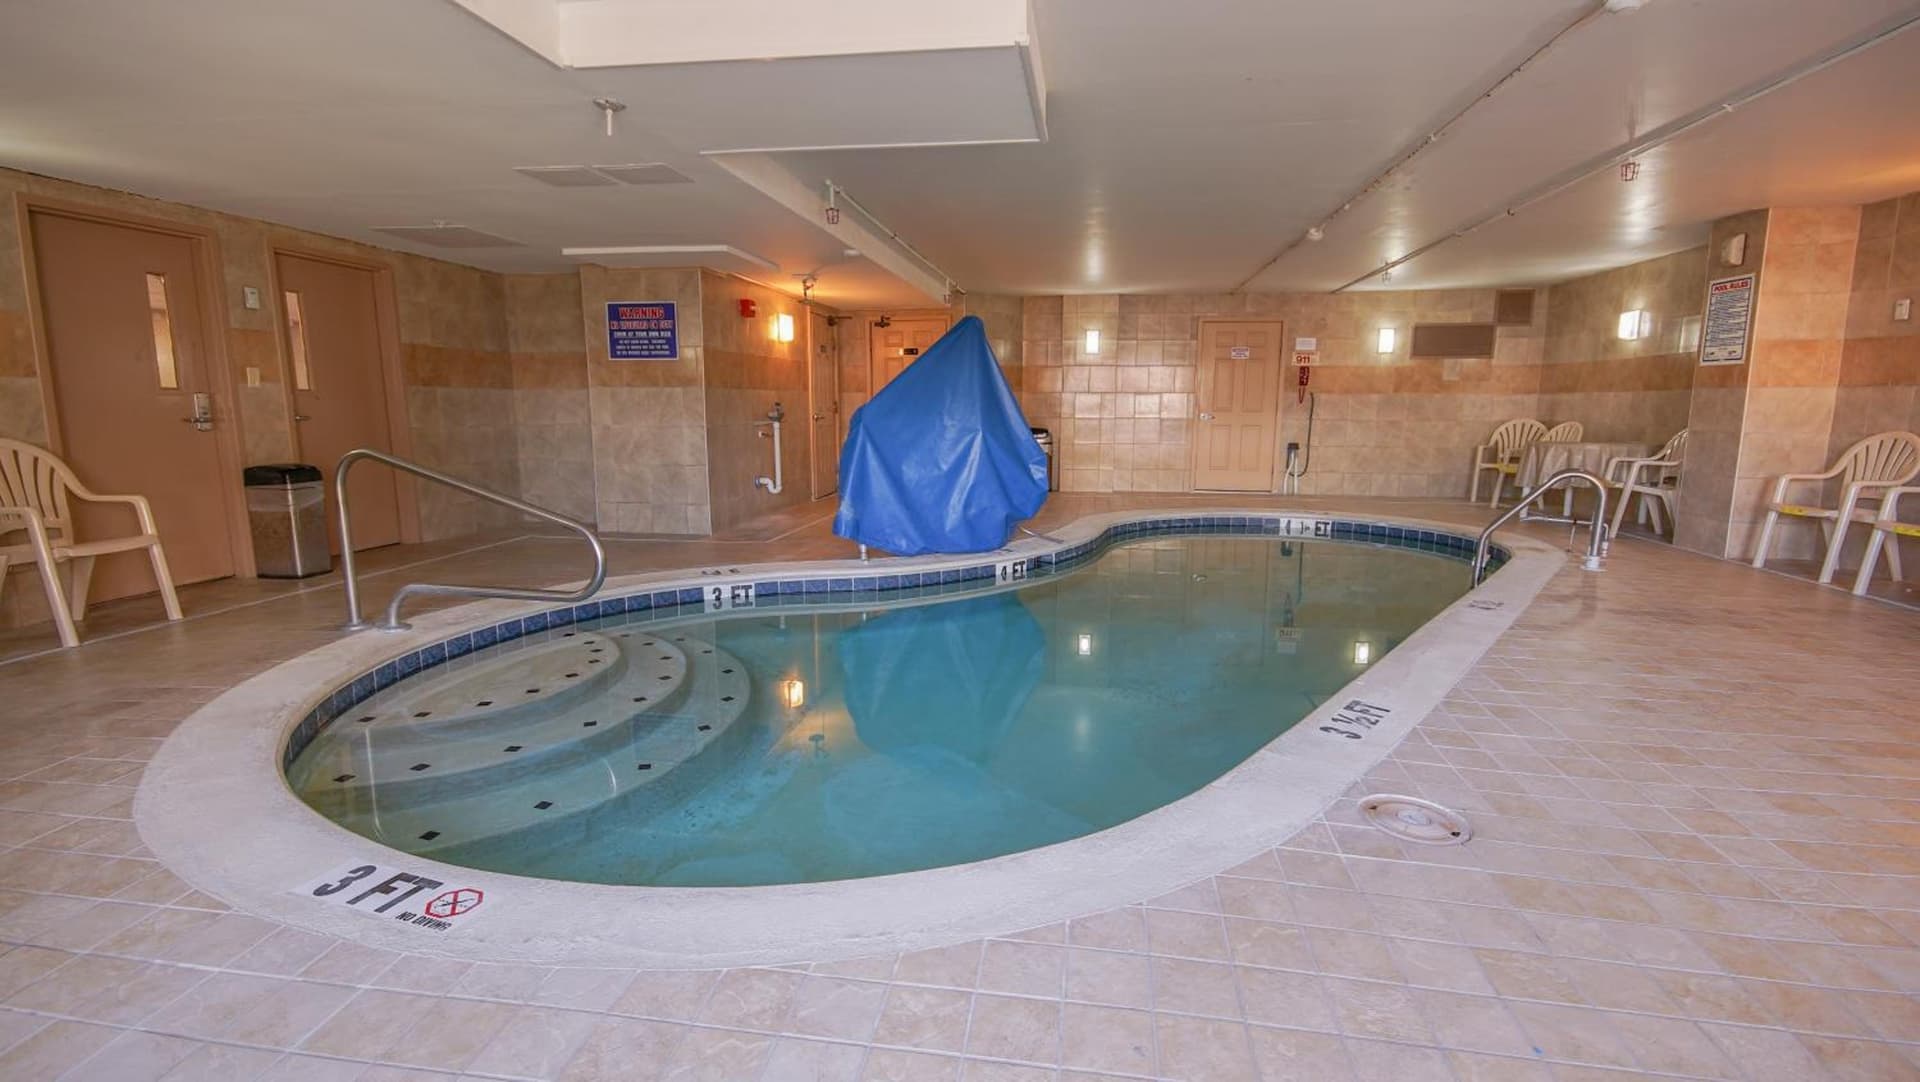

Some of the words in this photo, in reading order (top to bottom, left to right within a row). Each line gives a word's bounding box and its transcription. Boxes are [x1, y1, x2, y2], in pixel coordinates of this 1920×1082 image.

[619, 306, 665, 319] WARNING
[1295, 355, 1310, 364] 911
[712, 587, 722, 609] 3
[730, 585, 753, 608] FT
[1319, 726, 1362, 739] 3
[312, 865, 377, 896] 3
[346, 872, 444, 913] FT
[395, 911, 417, 920] NO
[411, 915, 452, 932] DIVING
